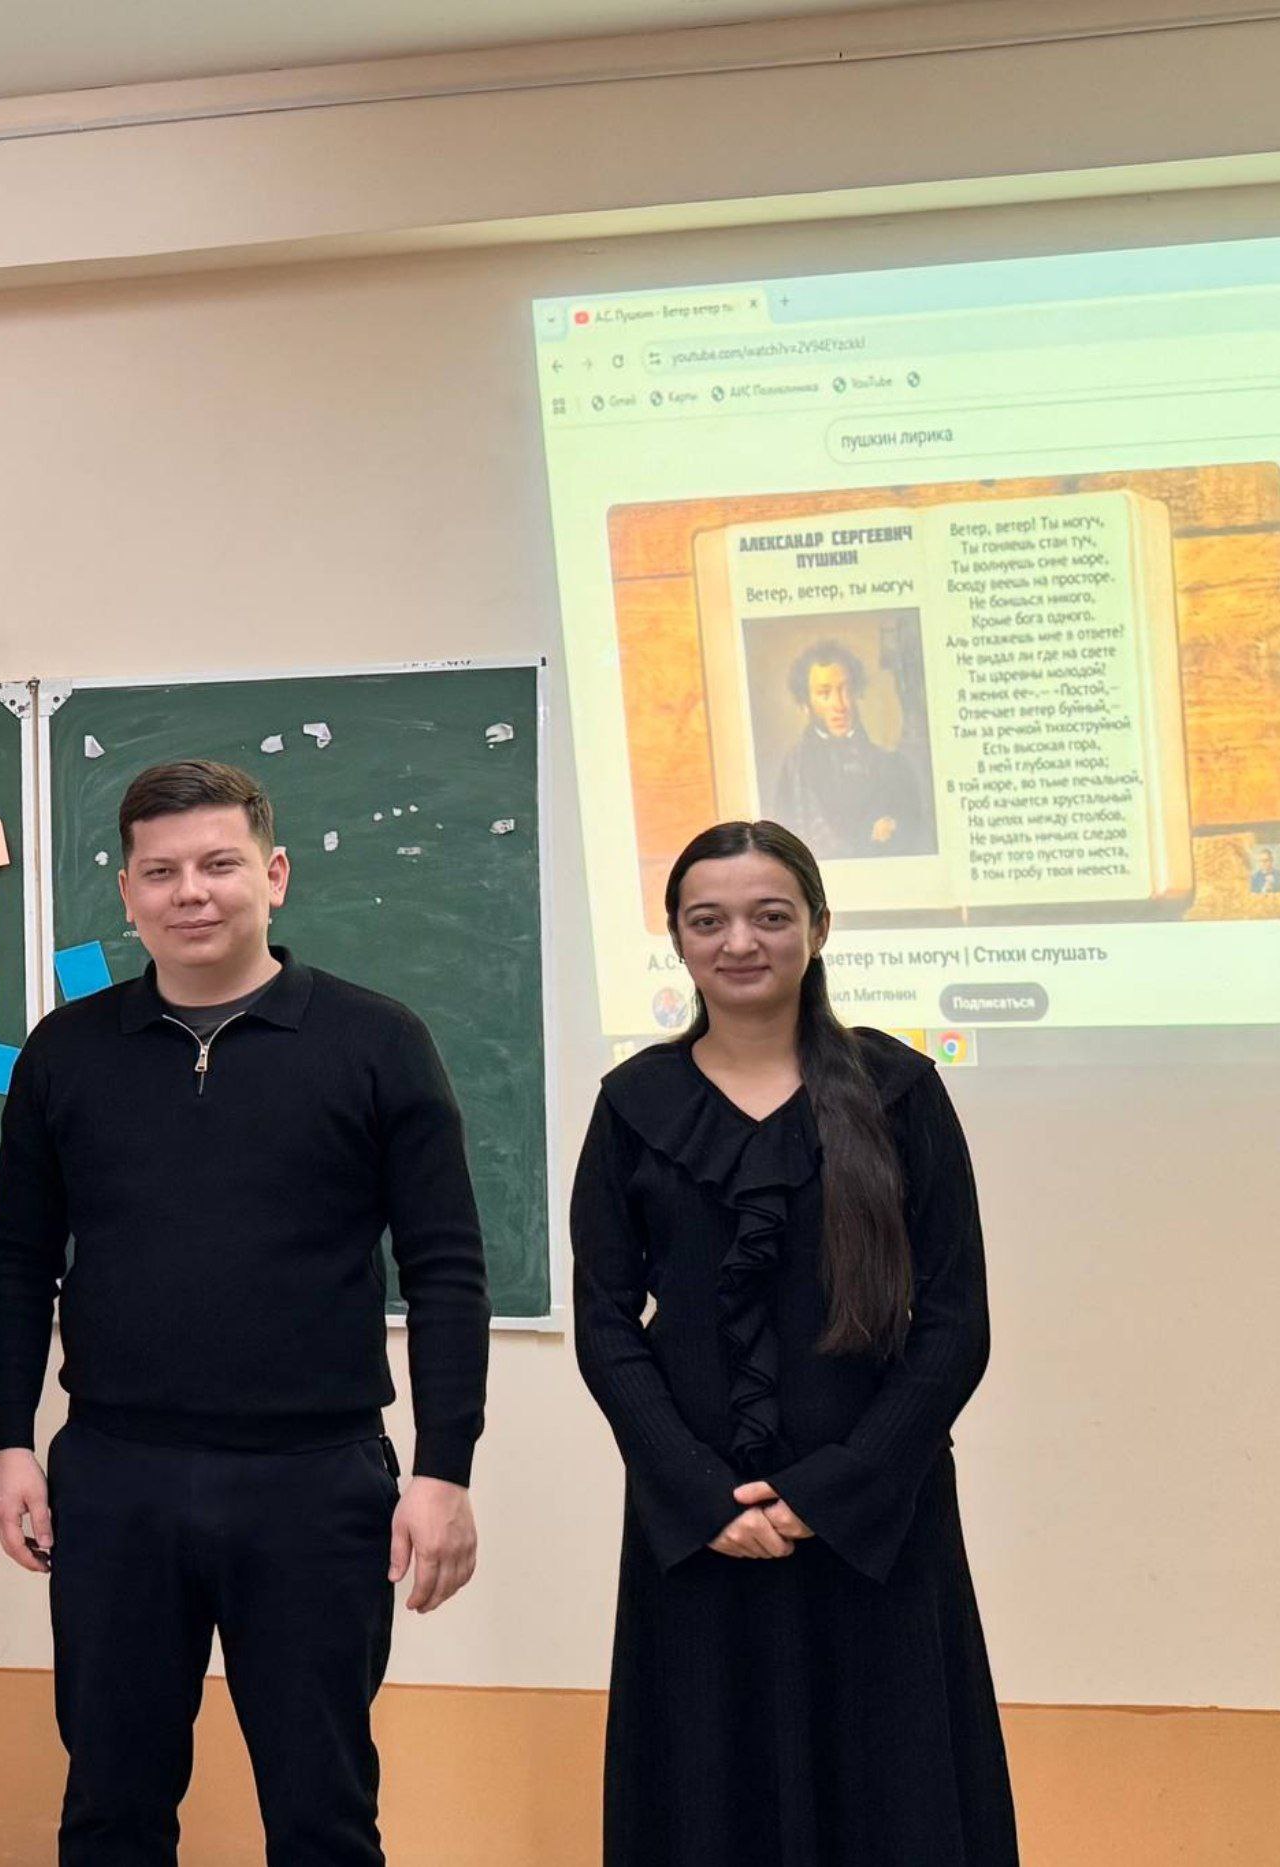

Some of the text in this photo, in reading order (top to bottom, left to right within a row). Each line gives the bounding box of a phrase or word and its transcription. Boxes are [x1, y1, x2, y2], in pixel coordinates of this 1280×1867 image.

[841, 428, 953, 453] пушкин лирика
[950, 523, 991, 537] Ветер,
[996, 517, 1036, 534] ветер!
[1041, 516, 1058, 530] Ты
[739, 525, 913, 552] АЛЕКСАНДР СЕРГЕЕВИЧ
[961, 541, 979, 555] Ты
[796, 550, 858, 568] ПУШКИН
[951, 560, 969, 574] Ты
[746, 579, 914, 604] Ветер, ветер, ты могуч
[947, 579, 986, 594] Всюду
[1033, 575, 1048, 586] на
[969, 597, 986, 610] Не
[971, 614, 1012, 629] Кроме
[1015, 612, 1043, 625] бога
[1038, 630, 1063, 642] мне
[1077, 624, 1125, 641] ответе?
[956, 651, 973, 665] Не
[1037, 650, 1059, 662] где
[1062, 649, 1077, 659] на
[1080, 646, 1116, 658] свете
[969, 670, 986, 683] Ты
[1047, 661, 1106, 678] молодой?
[1020, 704, 1056, 717] ветер
[953, 725, 977, 738] Там
[981, 726, 993, 736] за
[997, 720, 1041, 738] речкой
[982, 742, 1009, 756] Есть
[1014, 740, 1065, 753] высокая
[977, 760, 985, 773] В
[989, 758, 1012, 771] ней
[1016, 756, 1071, 772] глубокая
[947, 779, 955, 793] В
[958, 777, 979, 791] той
[1021, 778, 1035, 789] во
[1040, 776, 1069, 787] тьме
[960, 796, 990, 811] Гроб
[969, 814, 984, 827] На
[988, 813, 1023, 828] цепях
[1027, 811, 1067, 825] между
[970, 832, 986, 845] Не
[1083, 827, 1127, 840] следов
[970, 850, 1003, 864] Вкруг
[1007, 849, 1034, 861] того
[1037, 847, 1085, 861] пустого
[971, 868, 979, 880] В
[983, 868, 1004, 879] том
[1008, 864, 1042, 880] гробу
[1047, 865, 1073, 876] твоя
[879, 952, 903, 965] ты
[909, 949, 959, 967] могуч
[974, 946, 1026, 963] Стихи
[1031, 947, 1108, 966] слушать
[953, 996, 1036, 1010] Подписаться
